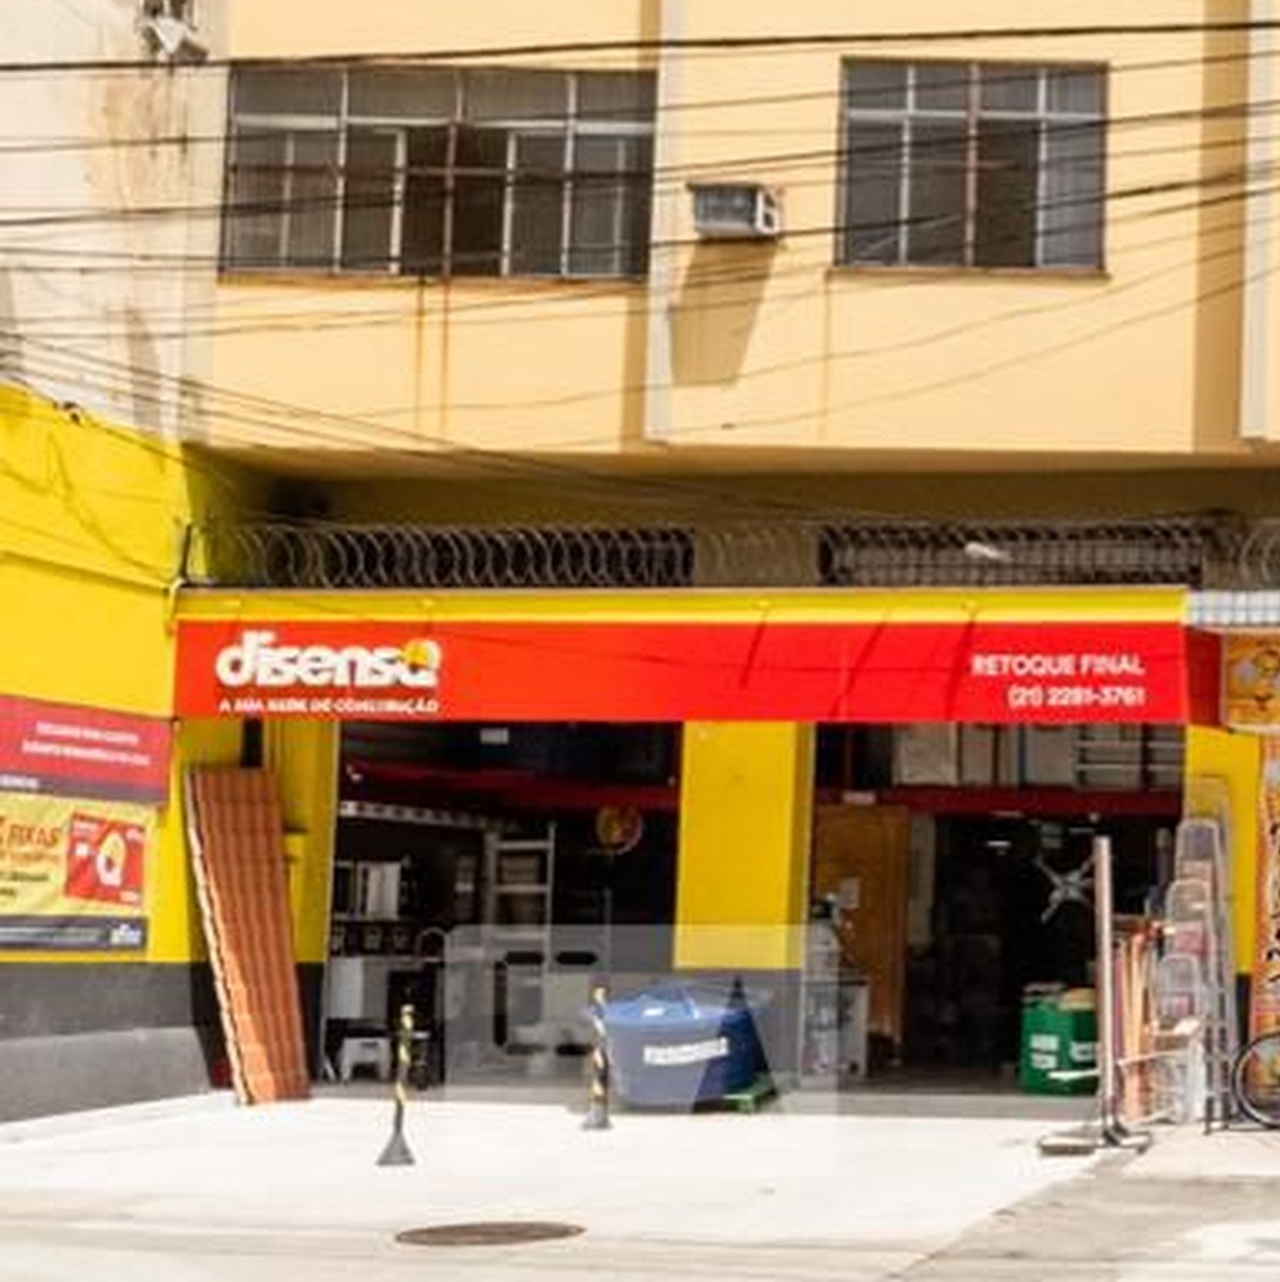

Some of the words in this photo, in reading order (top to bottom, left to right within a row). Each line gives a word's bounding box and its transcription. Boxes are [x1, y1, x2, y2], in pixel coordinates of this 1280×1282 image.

[215, 629, 442, 688] disensa
[972, 654, 1076, 676] RETOQUE
[1081, 654, 1147, 676] FINAL
[1007, 683, 1044, 710] (21)
